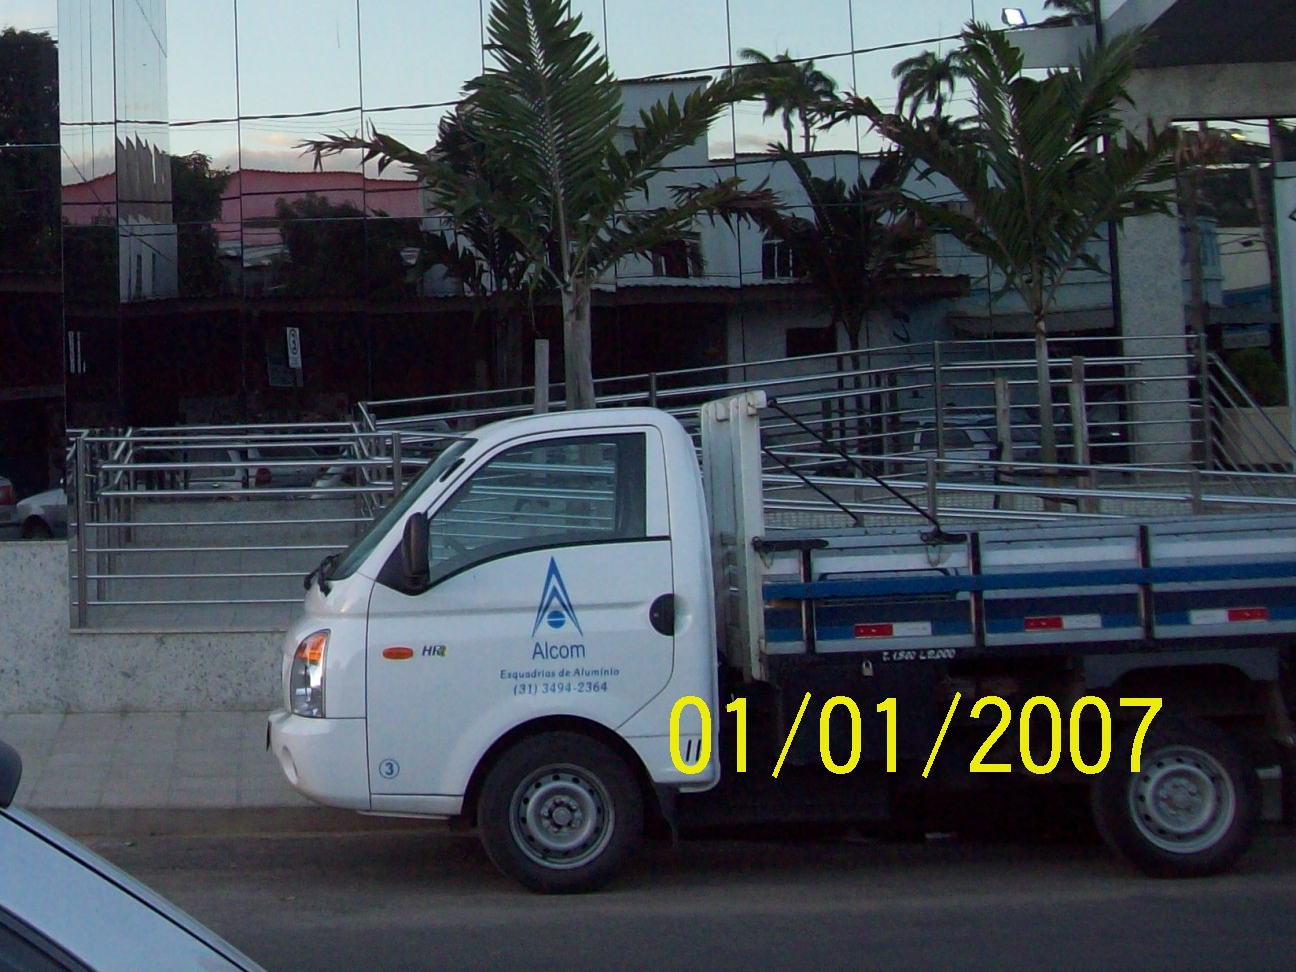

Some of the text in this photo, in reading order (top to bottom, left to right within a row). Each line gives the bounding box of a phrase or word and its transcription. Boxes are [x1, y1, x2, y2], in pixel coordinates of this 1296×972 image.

[532, 641, 585, 660] Alcom
[500, 669, 556, 680] Esquadrias
[558, 668, 571, 678] de
[513, 681, 608, 696] (31) 3494-2364
